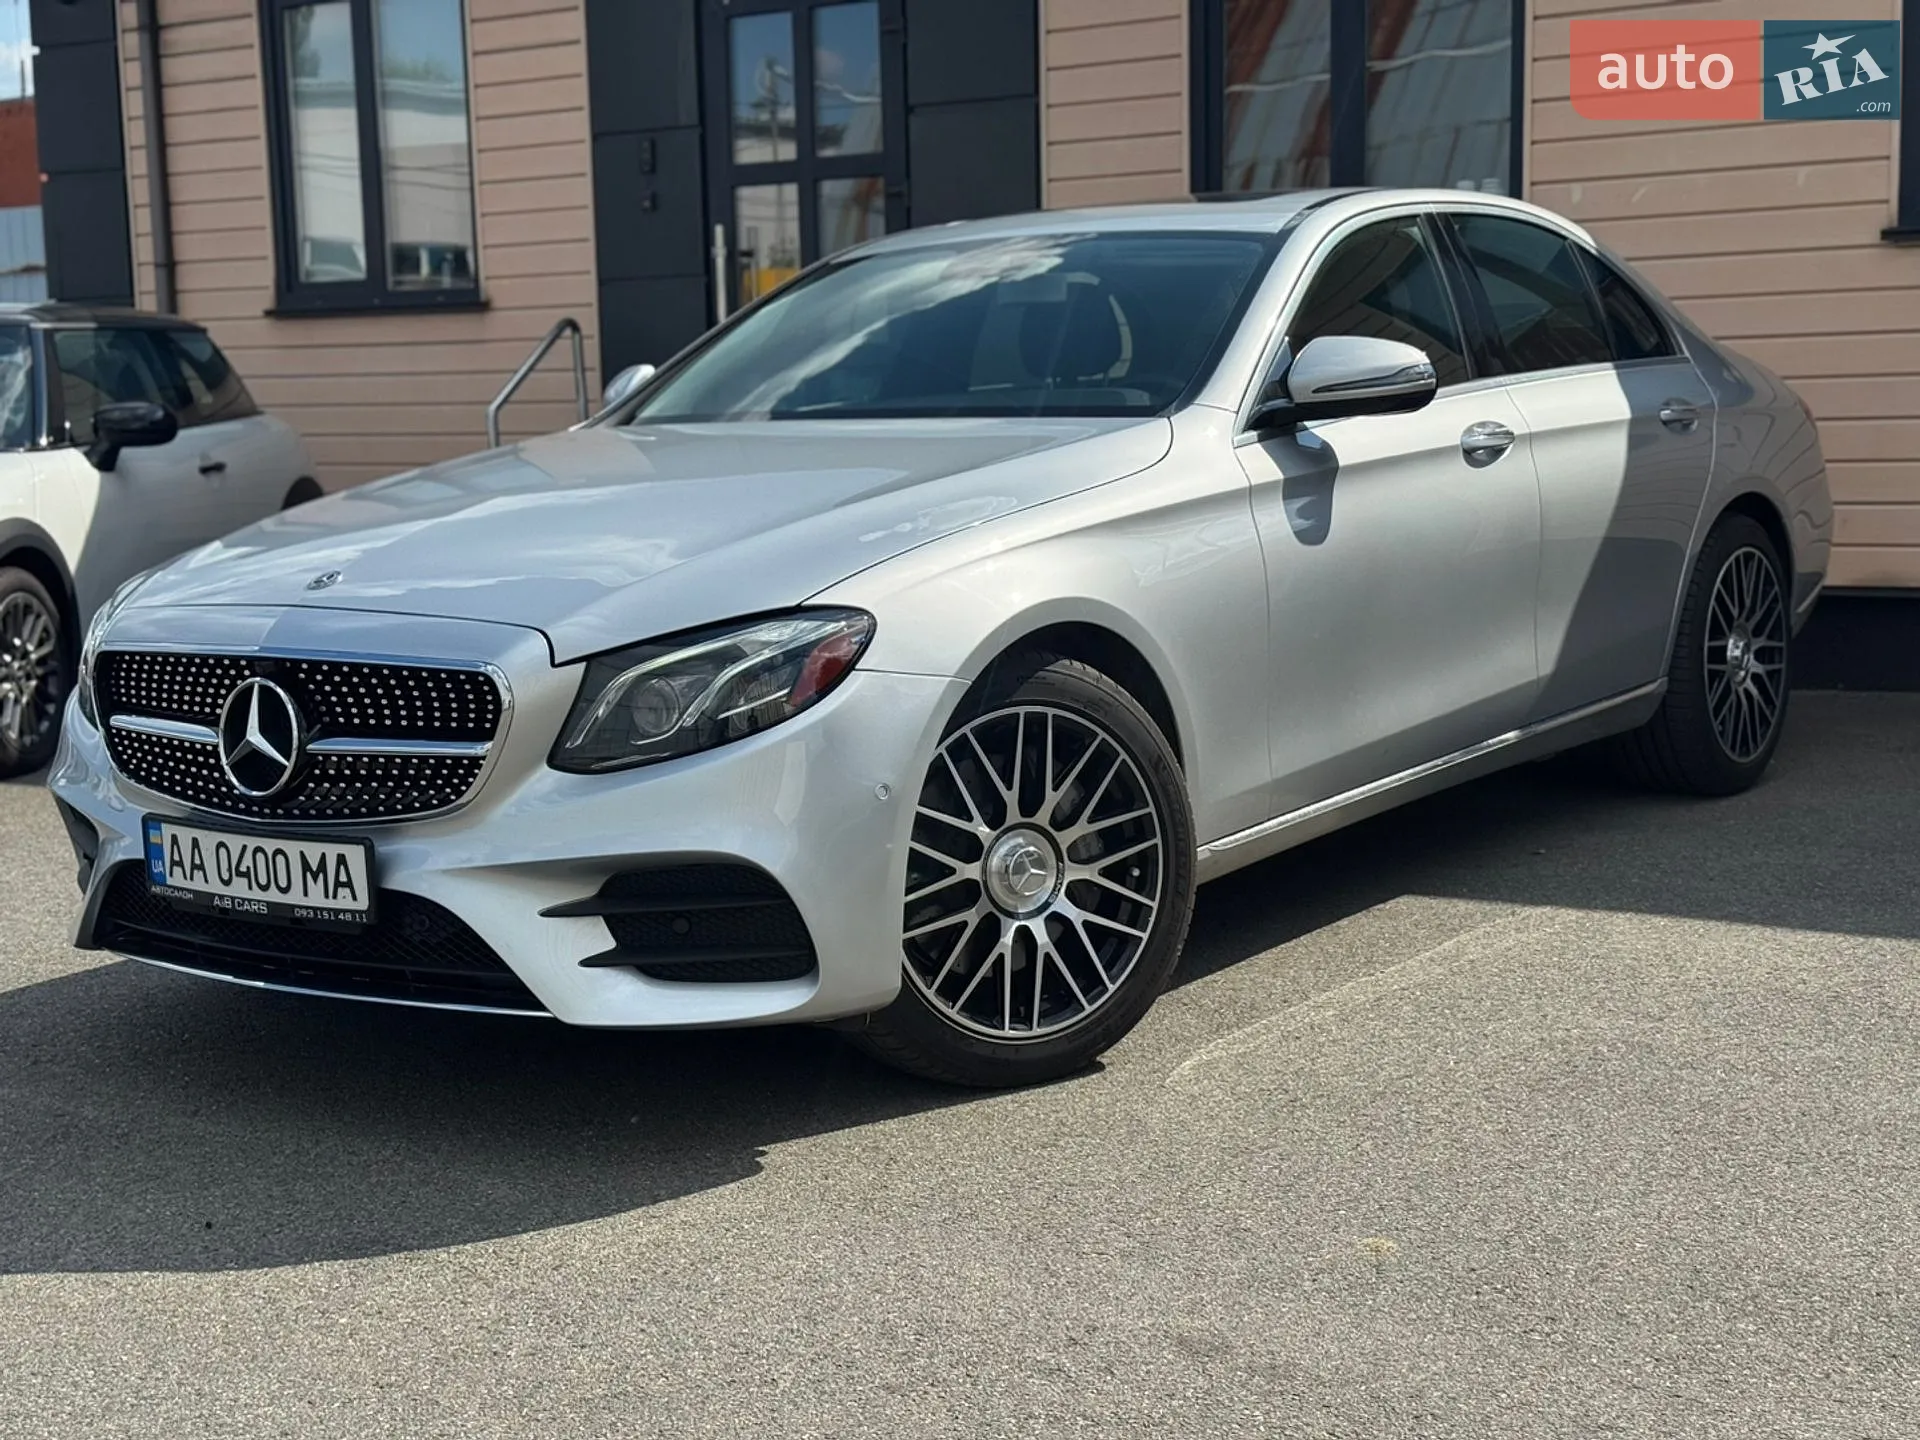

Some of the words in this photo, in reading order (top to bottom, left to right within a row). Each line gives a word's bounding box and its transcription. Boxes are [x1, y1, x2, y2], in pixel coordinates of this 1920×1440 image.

[151, 859, 164, 873] UA
[169, 833, 209, 884] AA
[215, 841, 292, 894] 0400
[299, 850, 358, 901] MA
[234, 898, 268, 914] CARS
[294, 908, 314, 918] 093
